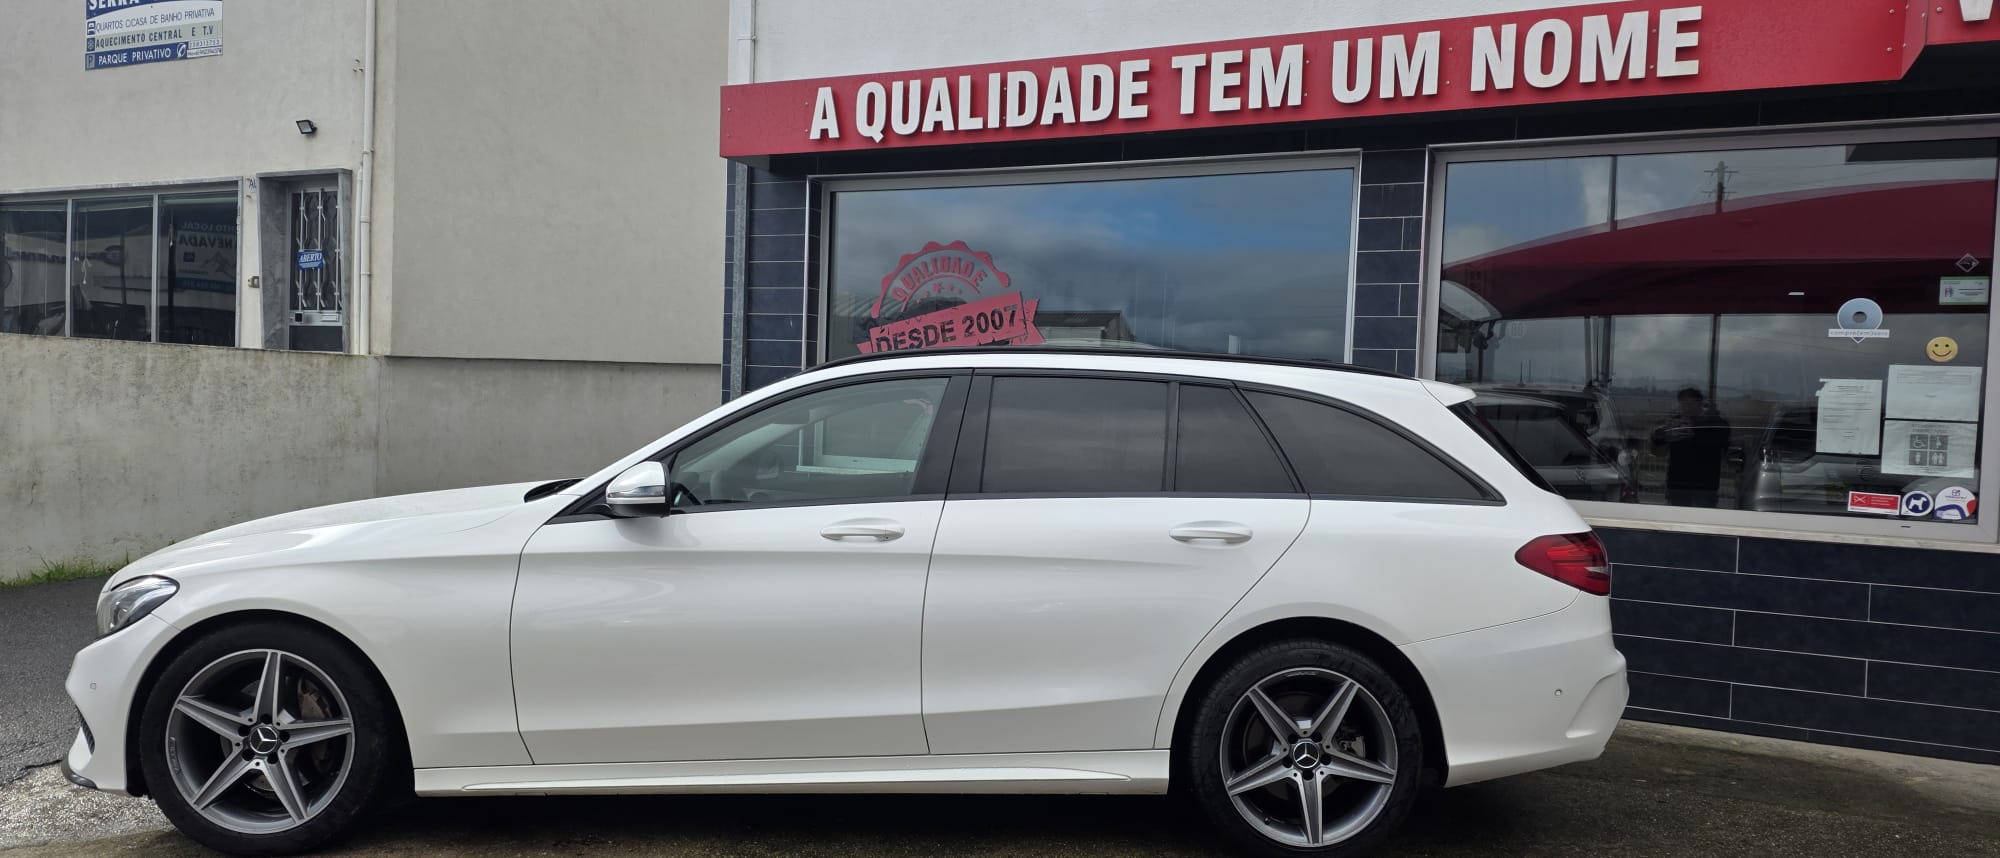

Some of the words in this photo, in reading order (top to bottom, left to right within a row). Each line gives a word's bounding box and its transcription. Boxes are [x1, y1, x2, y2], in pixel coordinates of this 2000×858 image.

[96, 20, 124, 32] QUARTOS
[150, 14, 159, 25] DE
[160, 11, 182, 23] BANHO
[184, 8, 215, 20] PRIVATIVA
[95, 33, 146, 48] AQUECIMENTO
[149, 29, 183, 42] CENTRAL
[191, 27, 196, 37] E
[98, 53, 128, 65] PARQUE
[132, 48, 171, 62] PRIVATIVO
[809, 86, 840, 140] A
[855, 58, 1151, 144] QUALIDADE
[1171, 43, 1304, 115] TEM
[1331, 30, 1441, 104] UM
[1470, 5, 1703, 92] NOME
[299, 252, 323, 262] ABERTO
[891, 255, 988, 302] QUALIDADE
[875, 321, 957, 352] DESDE
[962, 304, 1018, 338] 2007
